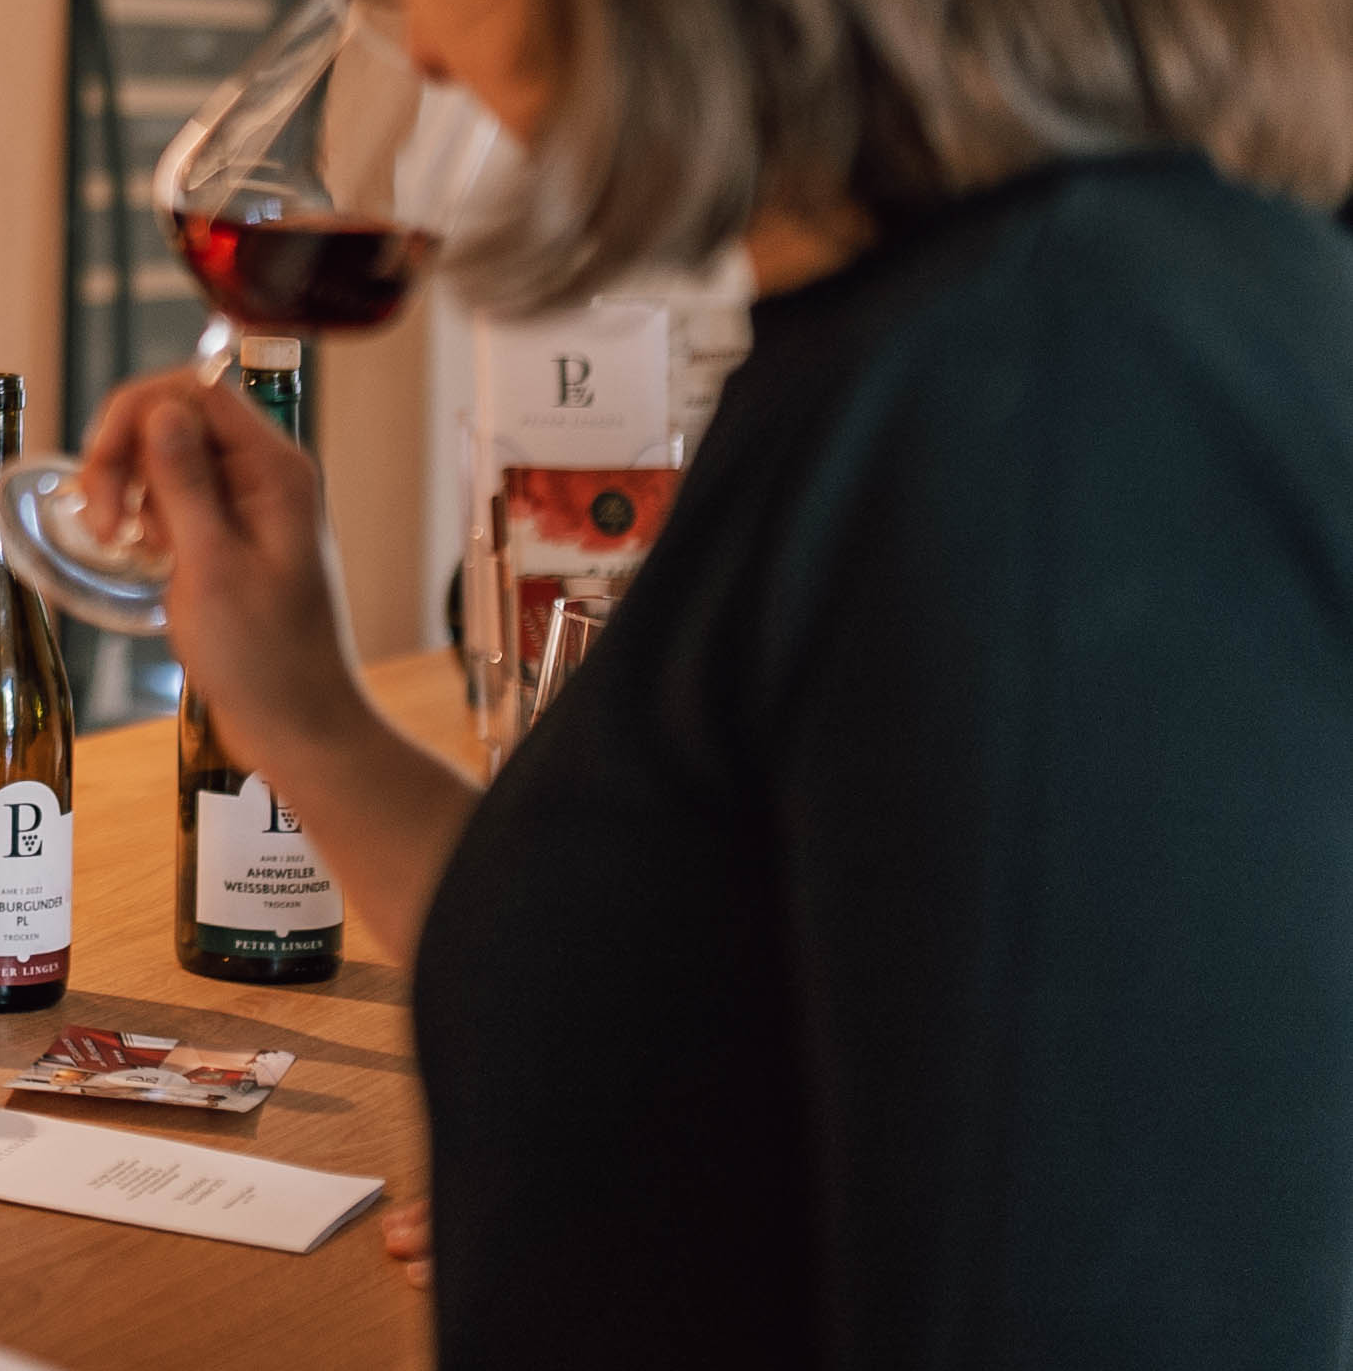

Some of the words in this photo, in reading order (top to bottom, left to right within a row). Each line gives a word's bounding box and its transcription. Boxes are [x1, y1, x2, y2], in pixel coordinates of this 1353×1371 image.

[246, 867, 316, 880] AHRWEILER
[224, 880, 331, 895] WEISSBURGUNDER
[16, 916, 29, 926] PL
[3, 933, 39, 941] TROCKEN
[235, 939, 275, 951] PETER
[23, 962, 59, 976] LINGEN
